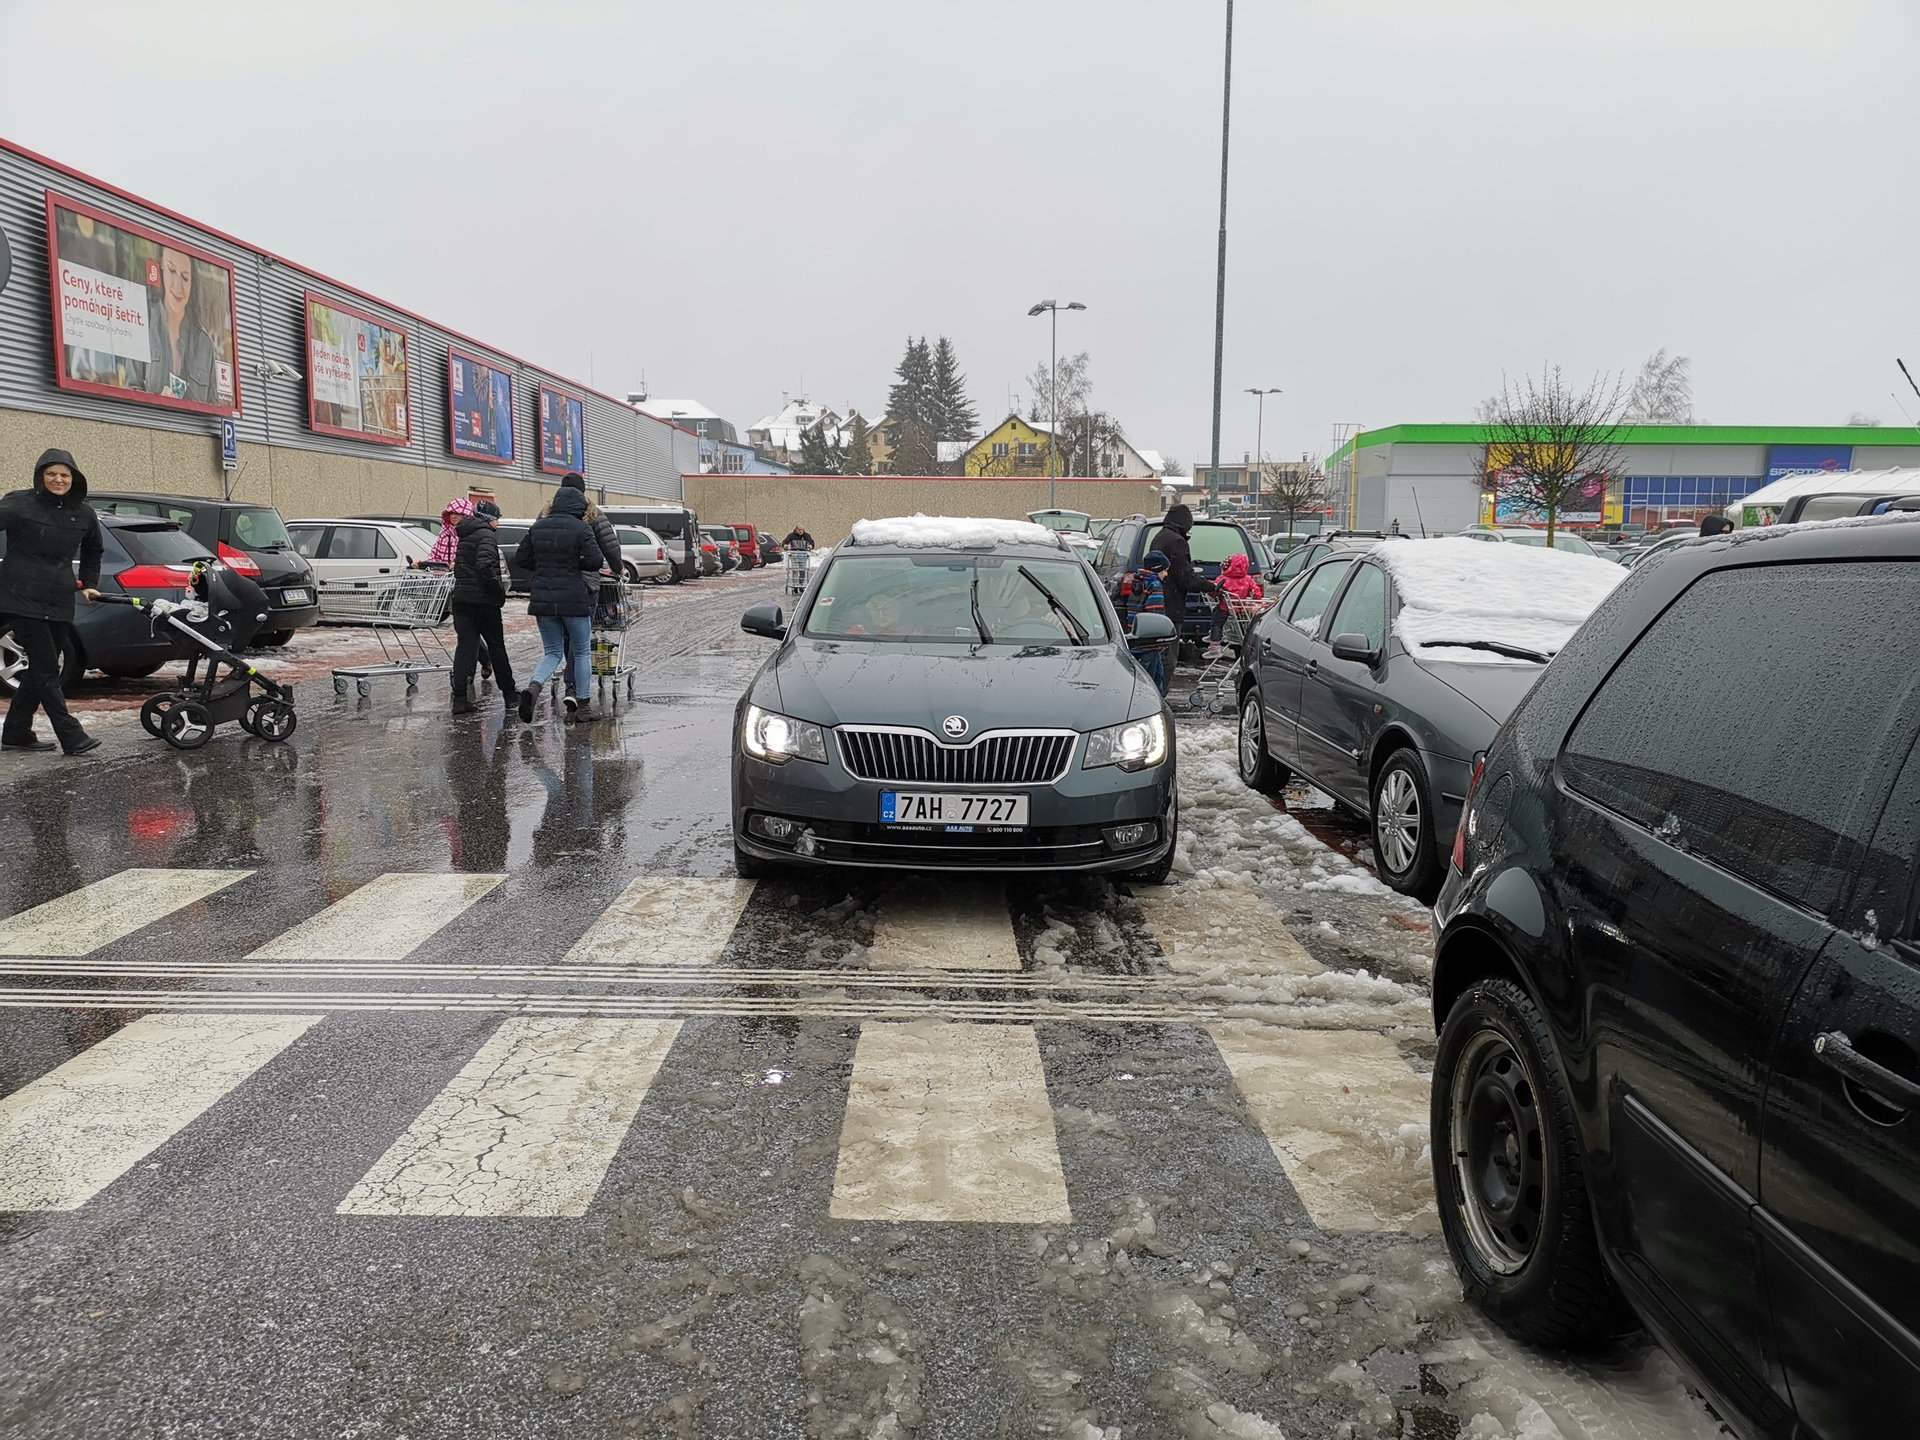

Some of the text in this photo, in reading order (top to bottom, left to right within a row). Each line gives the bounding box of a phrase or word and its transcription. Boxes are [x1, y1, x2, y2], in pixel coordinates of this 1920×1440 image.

[62, 269, 123, 301] Ceny, které
[64, 295, 144, 327] pomáhají šetřit.
[313, 344, 331, 360] Jeden
[313, 361, 324, 374] vše
[225, 423, 233, 447] P
[883, 810, 894, 819] CZ
[901, 796, 1017, 821] 7AH 7727
